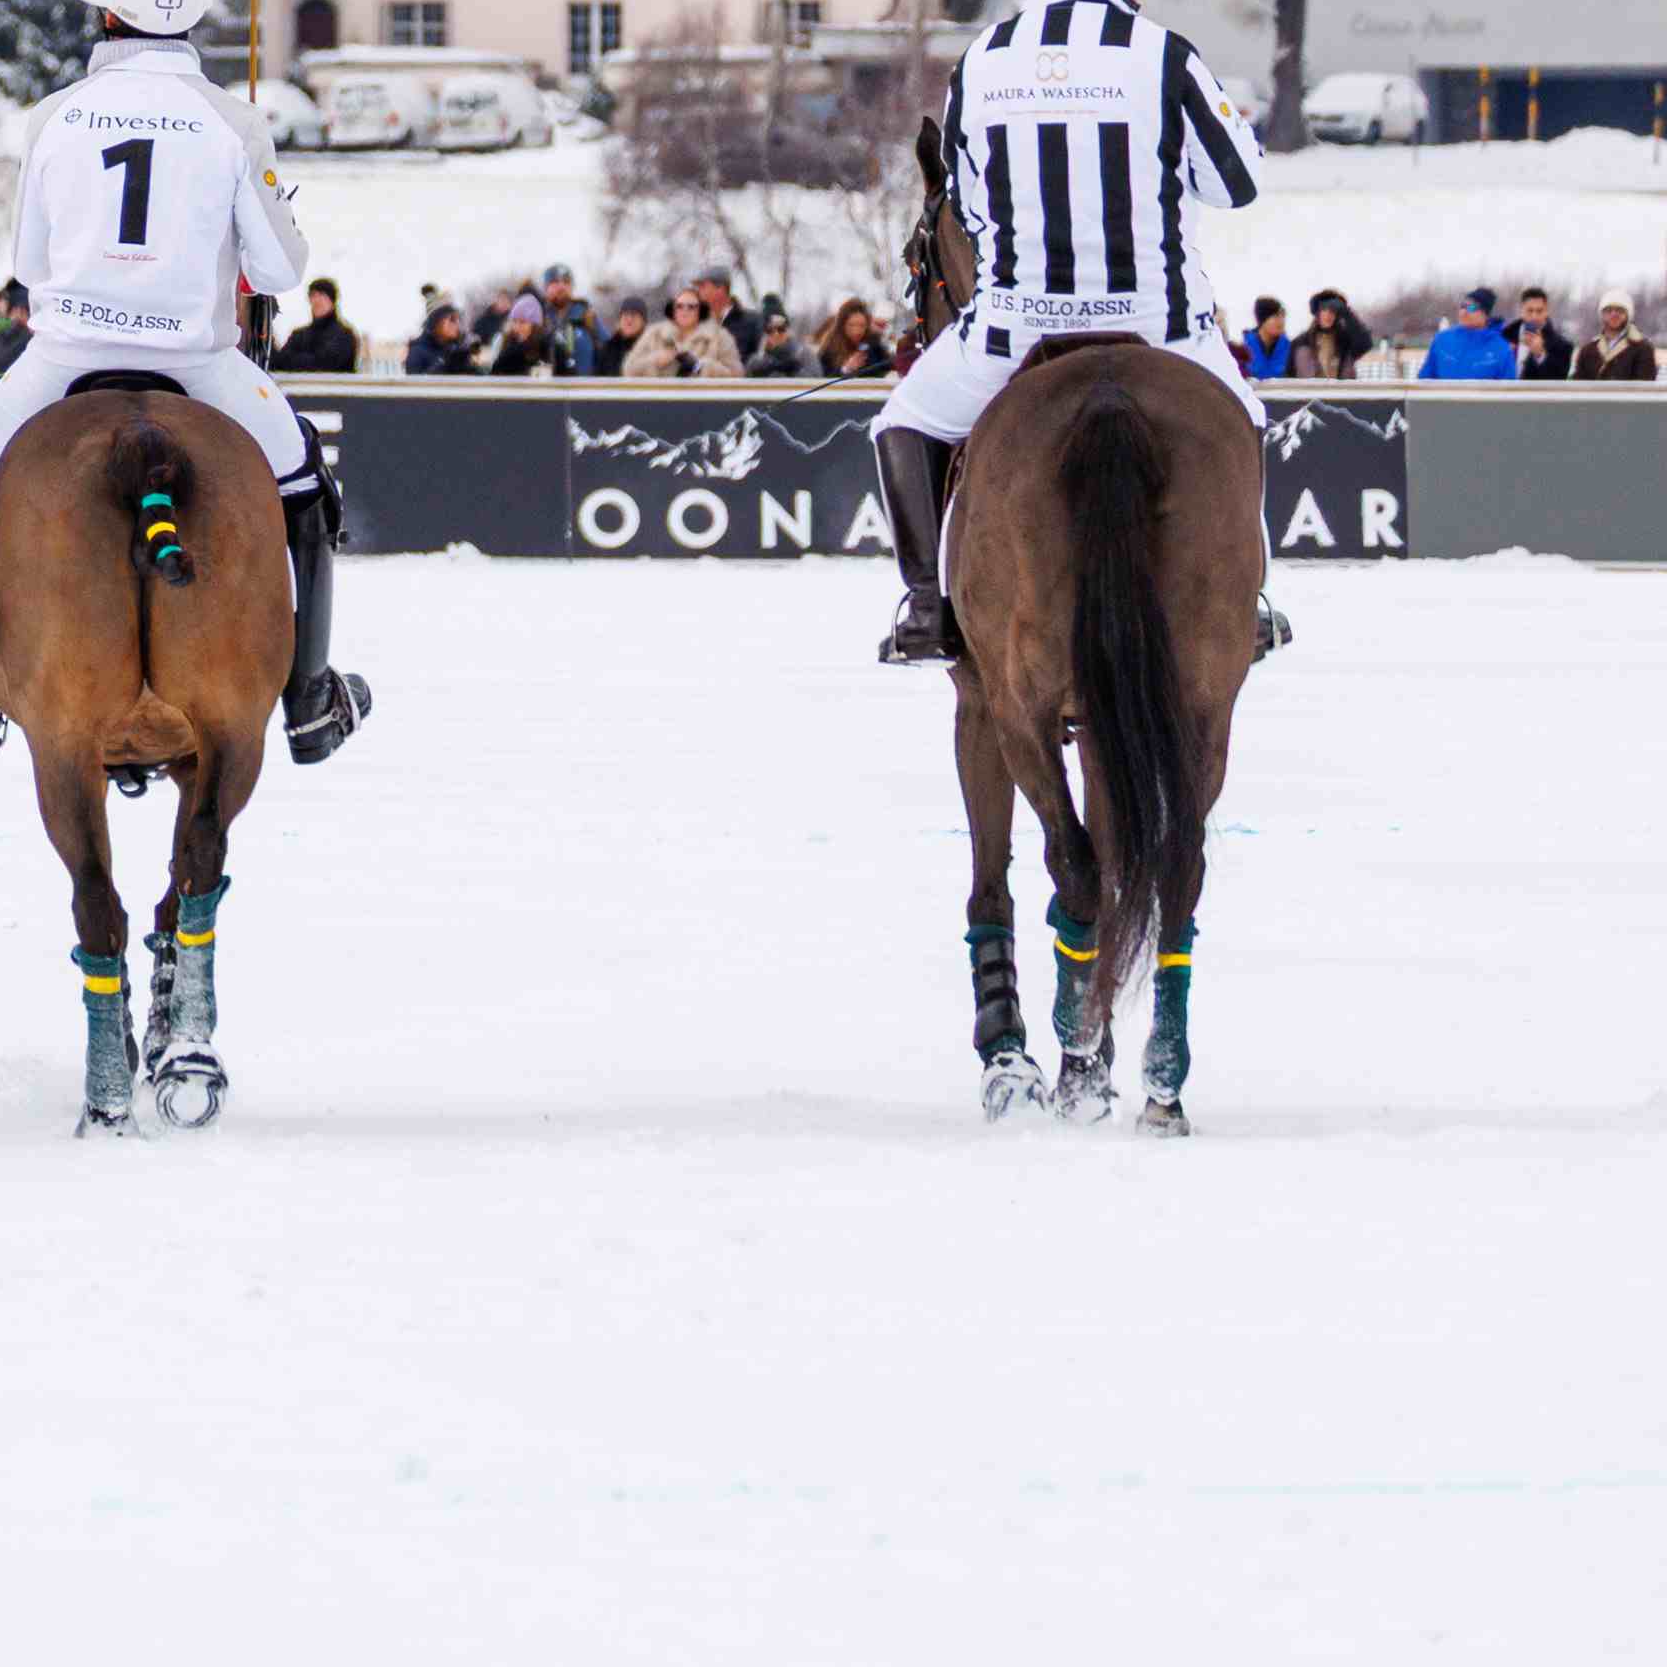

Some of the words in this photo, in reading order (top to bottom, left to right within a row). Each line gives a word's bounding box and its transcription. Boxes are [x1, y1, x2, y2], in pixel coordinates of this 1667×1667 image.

[983, 87, 1037, 103] MAURA
[1041, 85, 1126, 102] WASESCHA
[87, 111, 204, 134] Investec
[100, 138, 156, 246] 1
[77, 302, 129, 327] POLO
[130, 314, 185, 333] ASSN.
[1021, 297, 1074, 316] POLO
[1077, 299, 1137, 317] ASSN.
[577, 487, 897, 550] OONA
